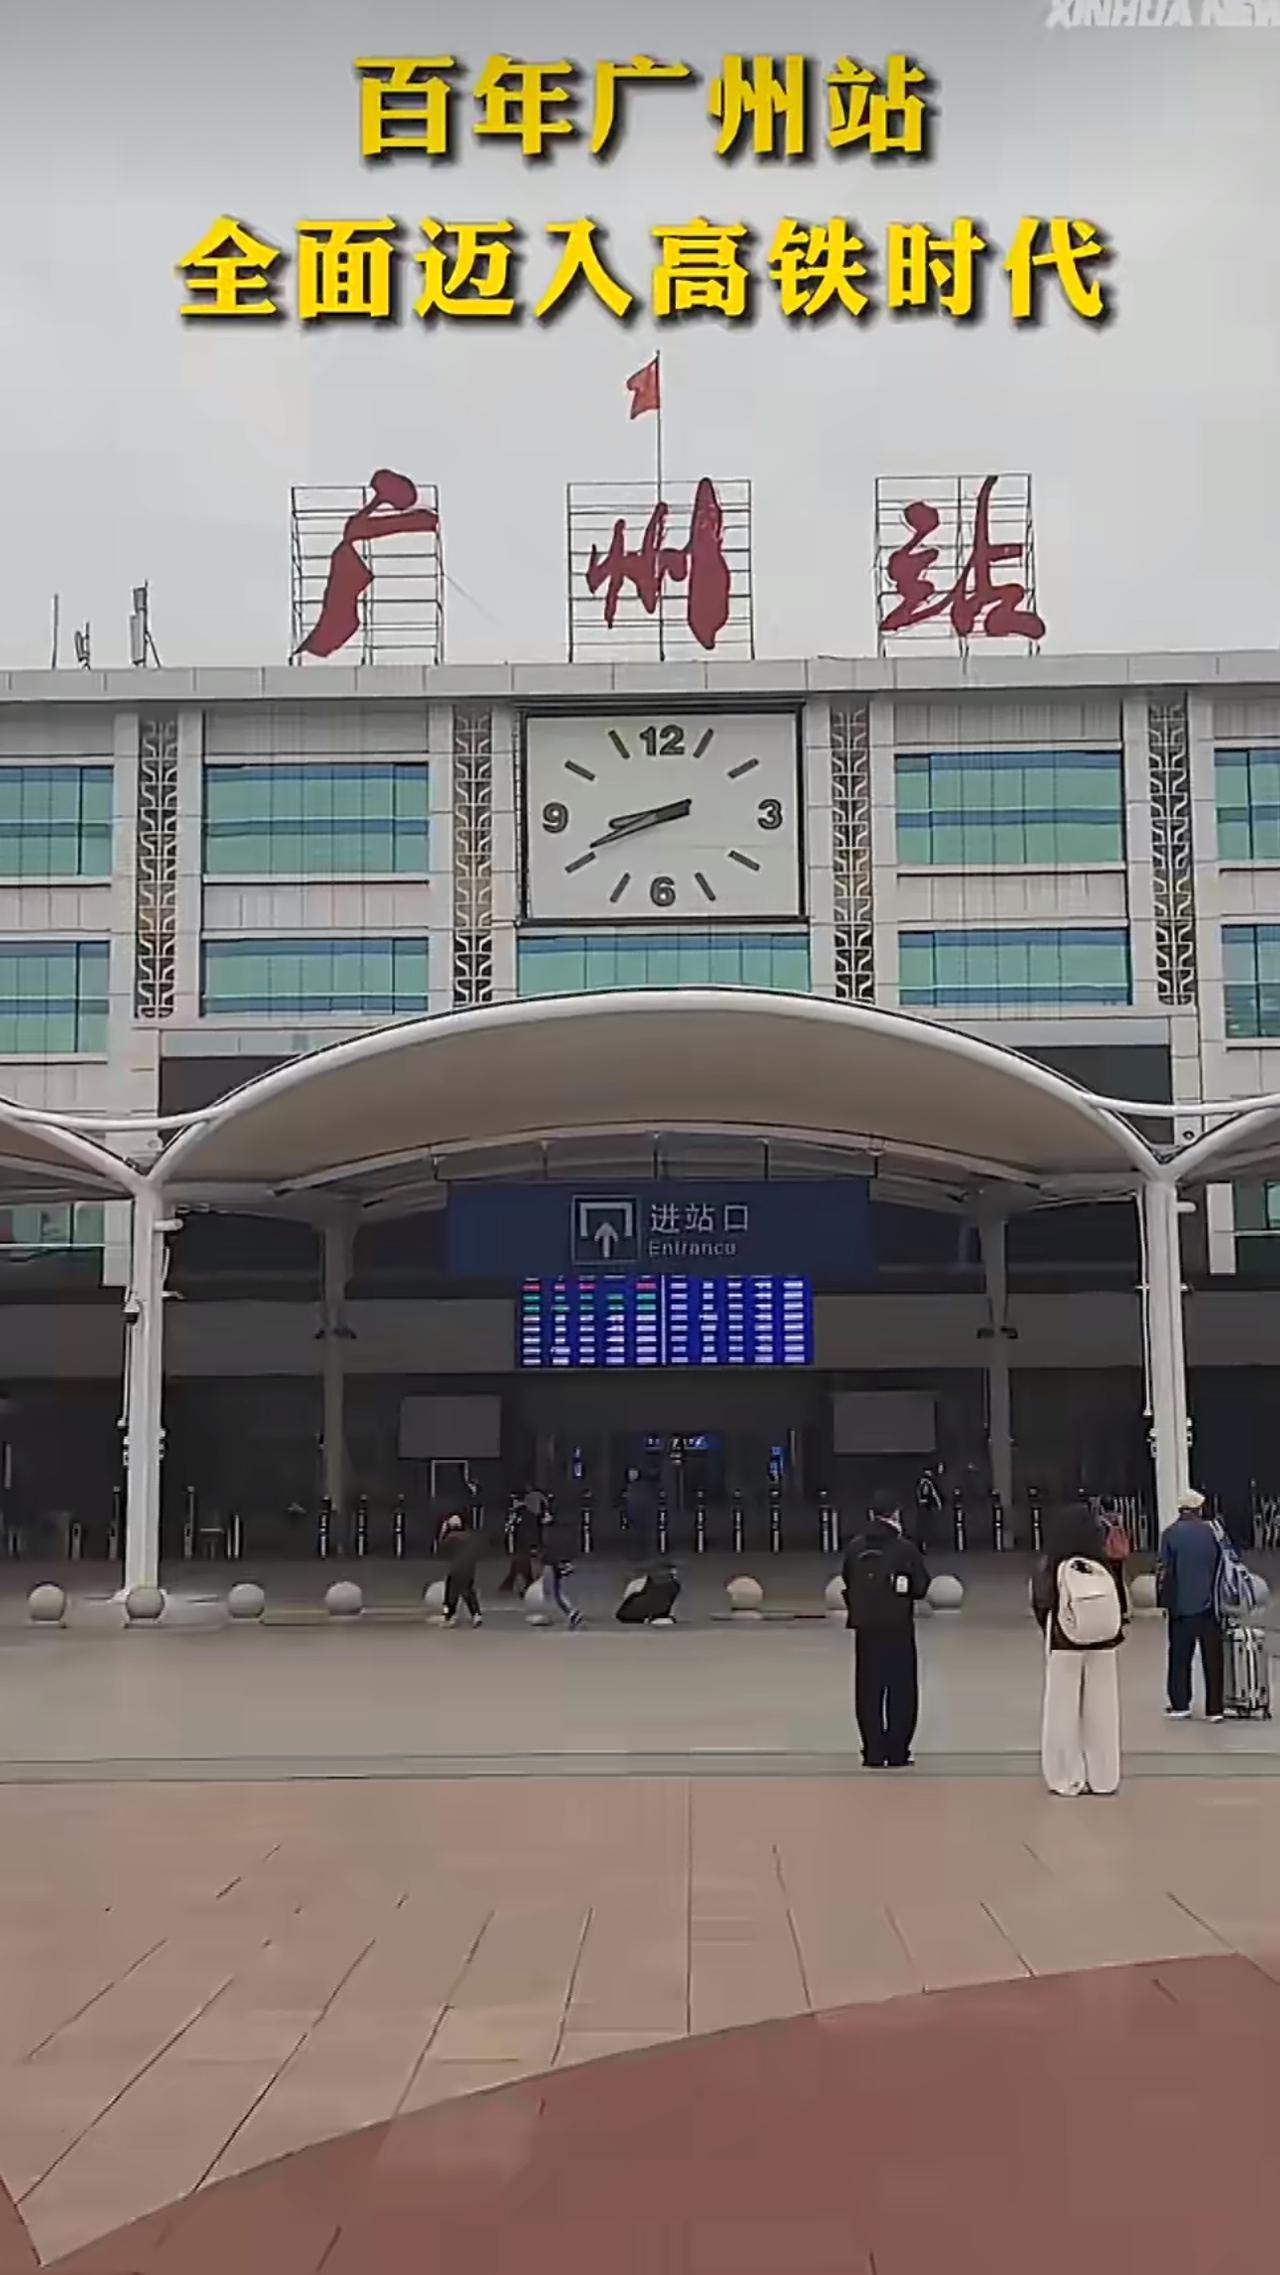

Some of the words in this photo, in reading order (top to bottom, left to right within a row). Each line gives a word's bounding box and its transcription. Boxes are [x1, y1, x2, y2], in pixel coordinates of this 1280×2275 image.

[296, 468, 1046, 658] 广州站
[639, 725, 685, 756] 12
[542, 802, 569, 833] 9
[757, 798, 783, 830] 3
[650, 876, 676, 907] 6
[651, 1203, 748, 1233] 进站口
